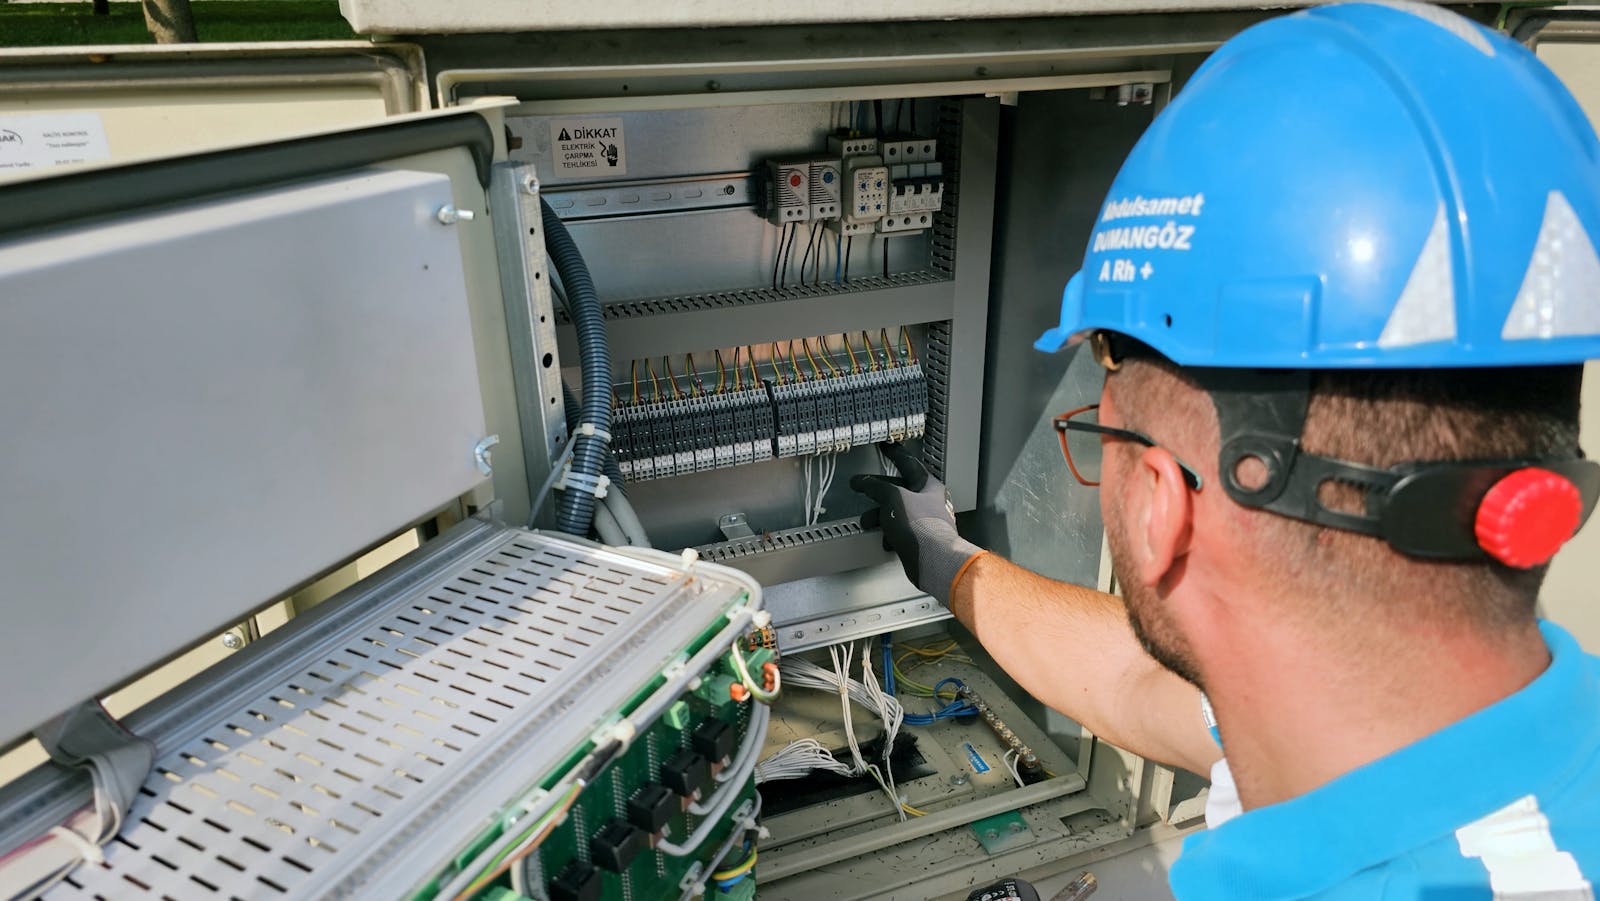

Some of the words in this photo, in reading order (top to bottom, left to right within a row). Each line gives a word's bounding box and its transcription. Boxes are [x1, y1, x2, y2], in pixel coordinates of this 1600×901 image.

[574, 126, 617, 139] DİKKAT
[561, 143, 596, 151] ELEKTRİK
[564, 152, 594, 160] ÇARPMA
[562, 160, 598, 168] TEHLİKESİ
[1093, 220, 1195, 253] DUMANGÖZ
[1099, 259, 1111, 282] A
[1112, 258, 1136, 282] Rh
